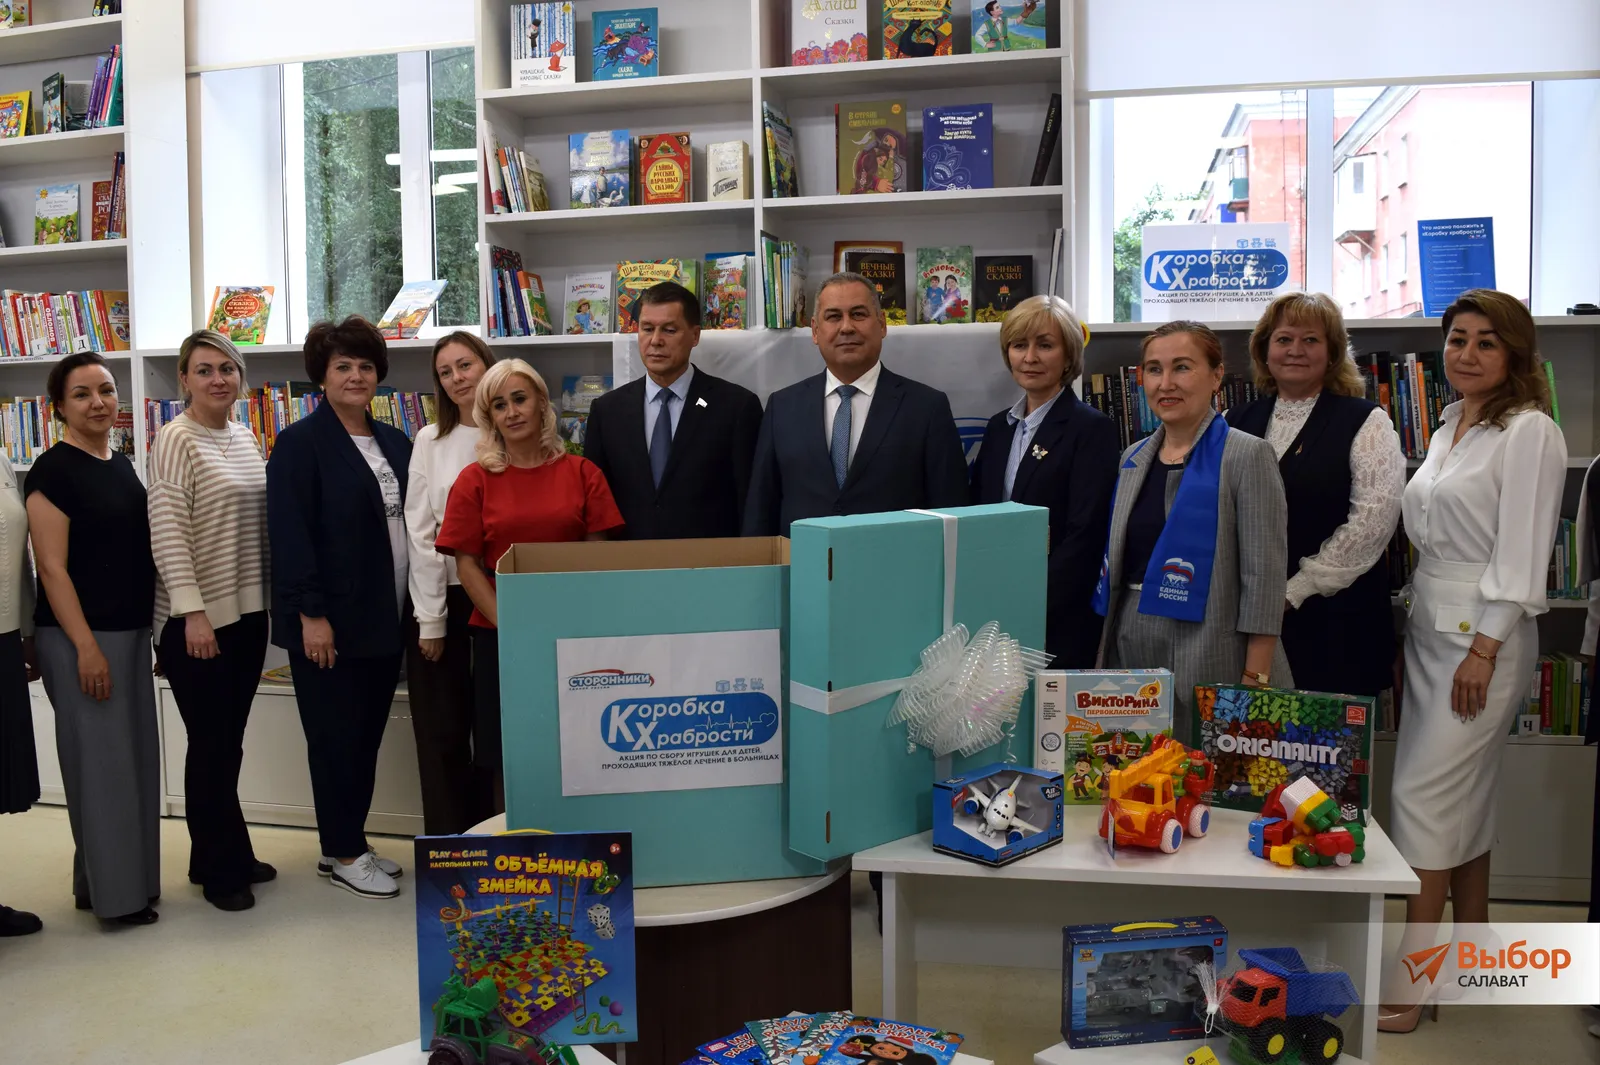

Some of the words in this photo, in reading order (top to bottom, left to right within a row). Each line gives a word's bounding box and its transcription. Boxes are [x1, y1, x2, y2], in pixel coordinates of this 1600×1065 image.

[824, 17, 855, 25] Сказки
[654, 183, 675, 191] СКАЗОК
[860, 262, 895, 271] ВЕЧНЫЕ
[986, 265, 1022, 273] ВЕЧНЫЕ
[1149, 251, 1245, 284] Коробка
[860, 270, 895, 278] СКАЗКИ
[986, 272, 1022, 281] СКАЗКИ
[1168, 267, 1268, 290] Храбрости
[45, 308, 56, 342] ОБЛОМОВ
[78, 339, 86, 351] Д
[1158, 592, 1188, 602] РОССИЯ
[1159, 586, 1189, 596] ЕДИНАЯ
[568, 674, 651, 687] СТОРОННИКИ
[607, 697, 725, 743] Коробка
[632, 721, 753, 751] Храбрости
[618, 754, 644, 762] АКЦИЯ
[659, 752, 684, 760] СБОРУ
[686, 750, 719, 758] ИГРУШЕК
[1216, 734, 1342, 765] ORIGINALITY
[601, 761, 657, 770] ПРОХОДЯЩИХ
[658, 758, 692, 767] ТЯЖЁЛОЕ
[694, 757, 726, 765] ЛЕЧЕНИЕ
[733, 753, 779, 763] БОЛЬНИЦАХ
[429, 850, 451, 859] PLAY
[461, 850, 488, 858] GAME
[429, 861, 471, 869] НАСТОЛЬНАЯ
[472, 860, 488, 868] ИГРА
[494, 852, 603, 877] ОБЪЁМНАЯ
[478, 874, 552, 894] ЗМЕЙКА
[760, 1024, 806, 1037] РАСКР
[878, 1021, 933, 1038] МУЛЬТ
[854, 1027, 947, 1052] РАСКРАСКА
